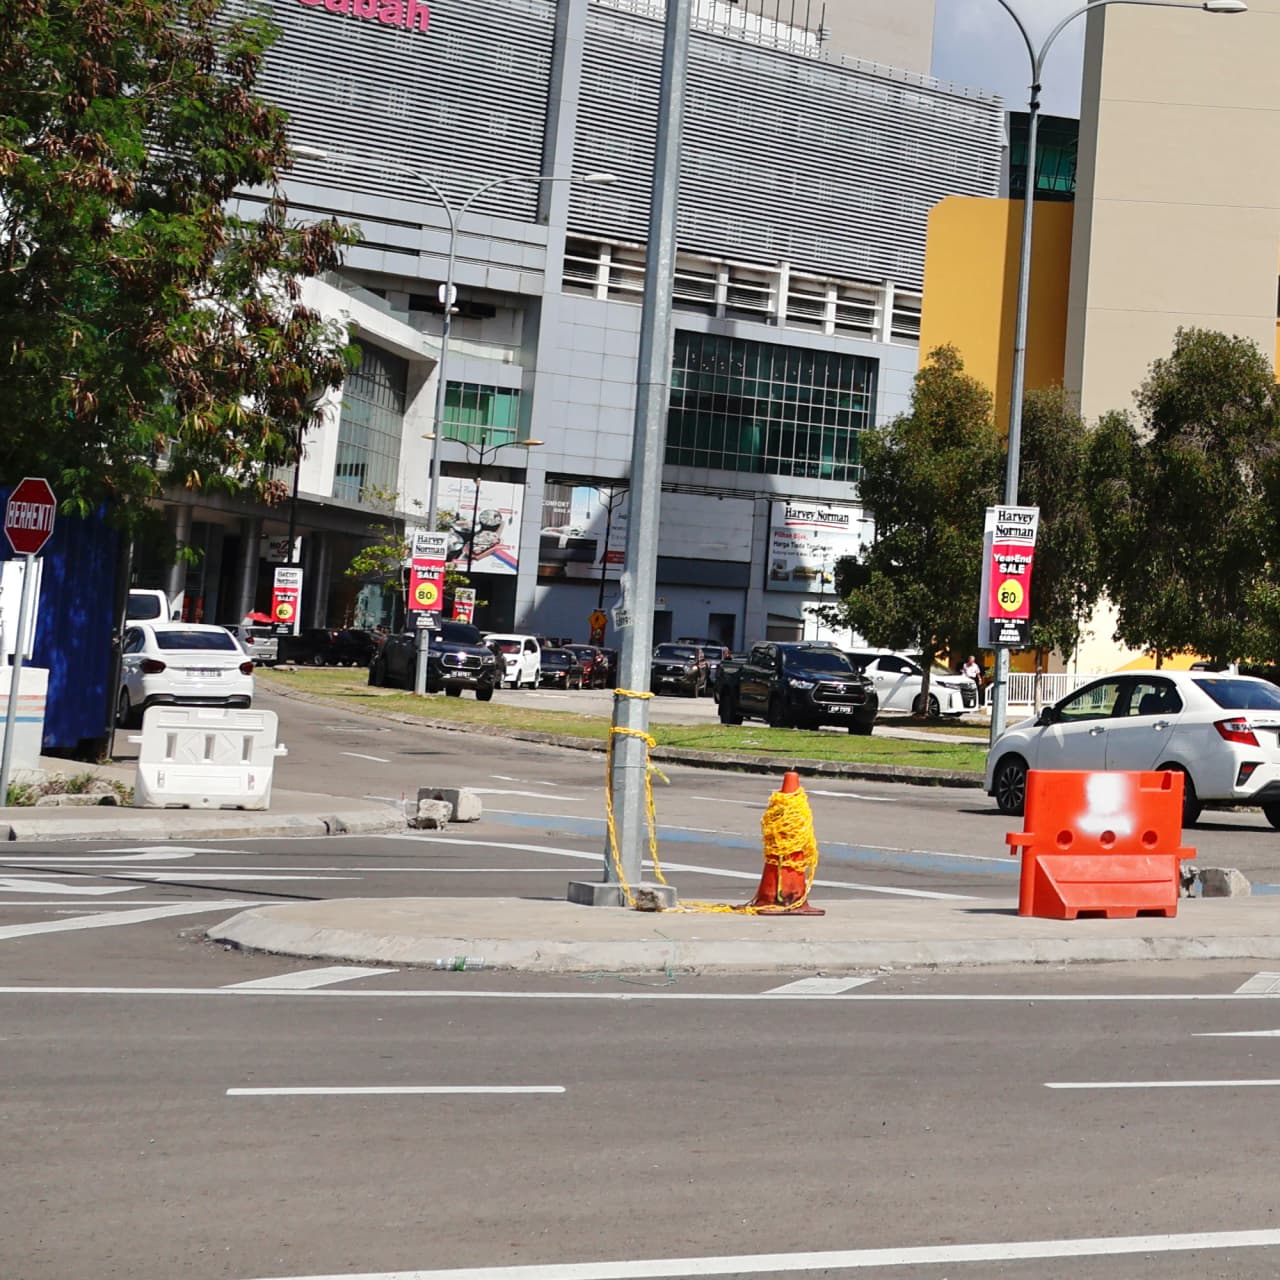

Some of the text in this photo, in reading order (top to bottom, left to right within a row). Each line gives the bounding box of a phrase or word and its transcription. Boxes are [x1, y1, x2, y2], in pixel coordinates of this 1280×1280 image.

[8, 501, 53, 531] BERHENTI
[785, 507, 849, 523] Harvey Norman
[998, 510, 1034, 525] Harvey
[995, 525, 1033, 537] Norman
[417, 534, 445, 545] Harvey
[415, 544, 445, 555] Norman
[993, 553, 1032, 564] Year-End
[999, 563, 1025, 574] SALE
[417, 571, 440, 580] SALE
